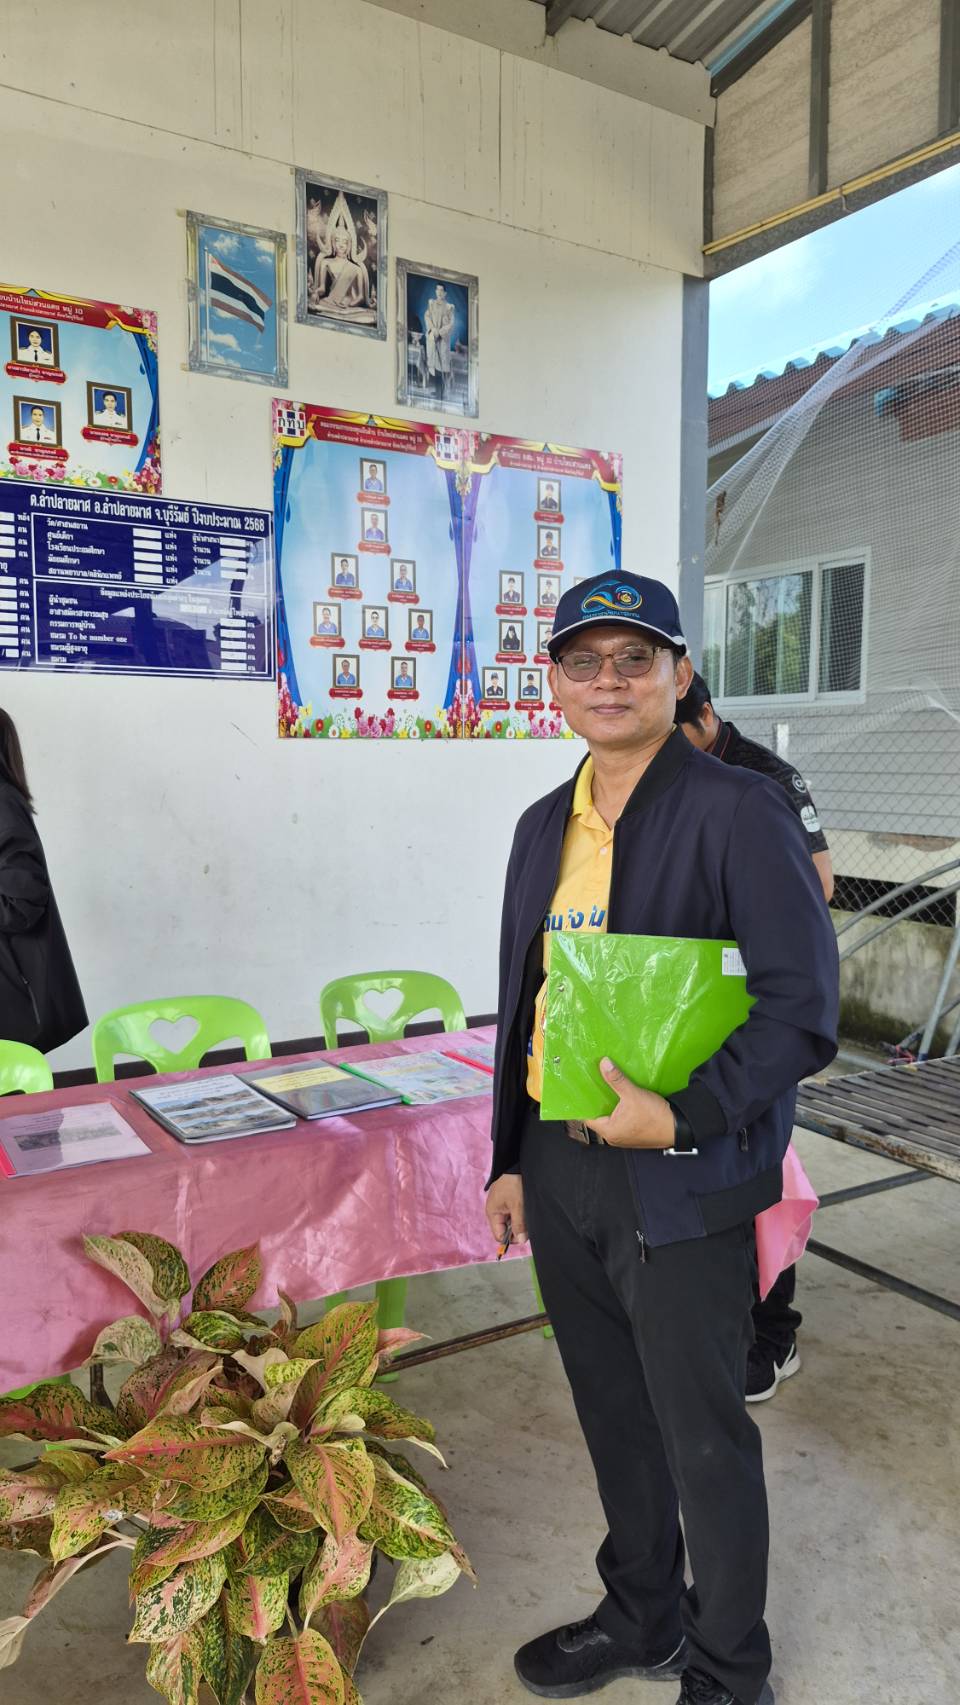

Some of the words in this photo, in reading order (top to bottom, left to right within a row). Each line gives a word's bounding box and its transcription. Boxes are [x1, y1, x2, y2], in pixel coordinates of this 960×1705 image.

[95, 498, 151, 518] อ.ลำปลายมาศ
[244, 517, 265, 532] 2568
[68, 632, 78, 640] To
[79, 633, 88, 641] be
[90, 634, 115, 642] number
